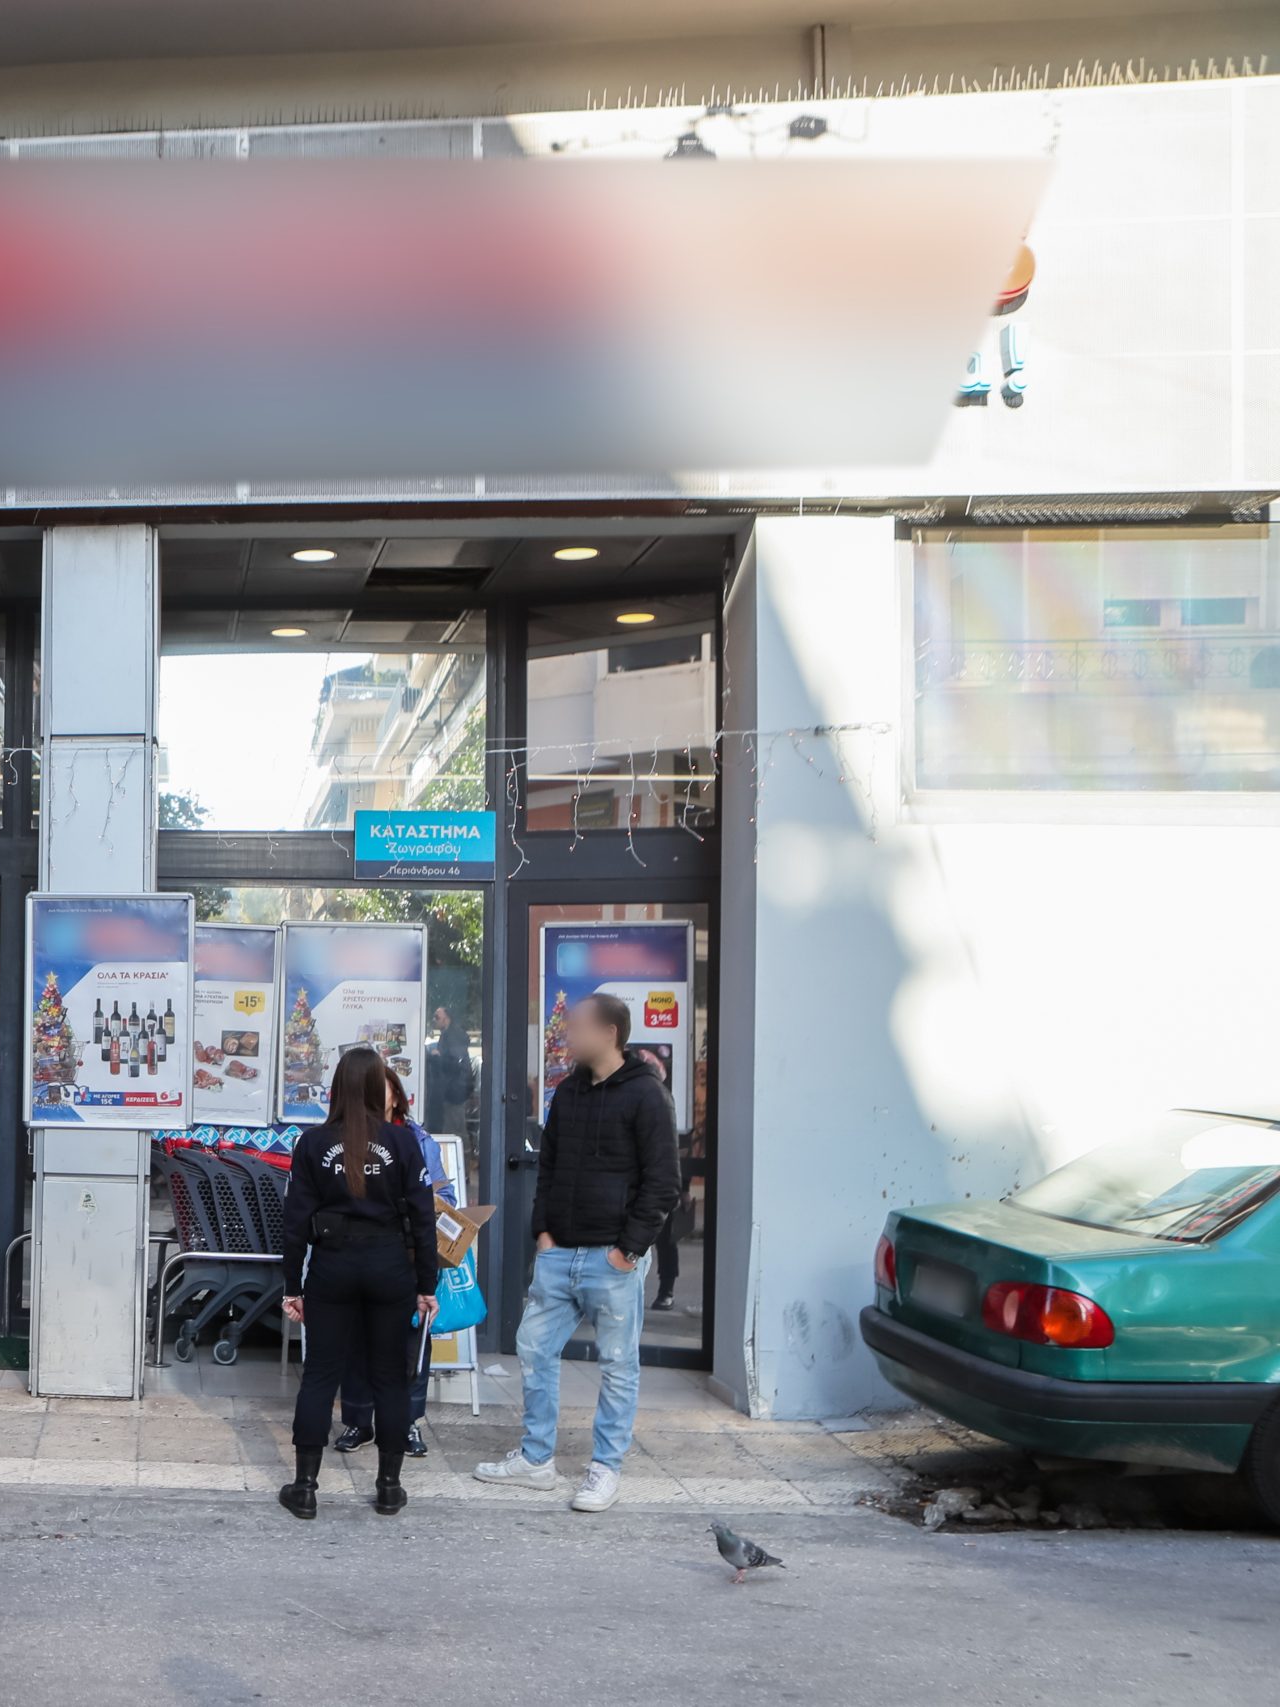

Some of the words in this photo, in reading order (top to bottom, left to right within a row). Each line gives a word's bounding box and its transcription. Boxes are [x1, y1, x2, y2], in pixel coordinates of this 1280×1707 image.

[370, 825, 480, 839] ΚΑΤΑΣΤΗΜΑ
[388, 842, 461, 856] Ζωγράφου
[389, 866, 446, 876] Περιάνδρου
[448, 867, 460, 875] 46
[97, 972, 118, 980] ΟΛΑ
[120, 972, 132, 980] ΤΑ
[321, 1142, 345, 1168] ΕΛΛΗΝΙ
[367, 1141, 394, 1166] ΤΥΝΟΜΙΑ
[334, 1163, 381, 1175] PCE
